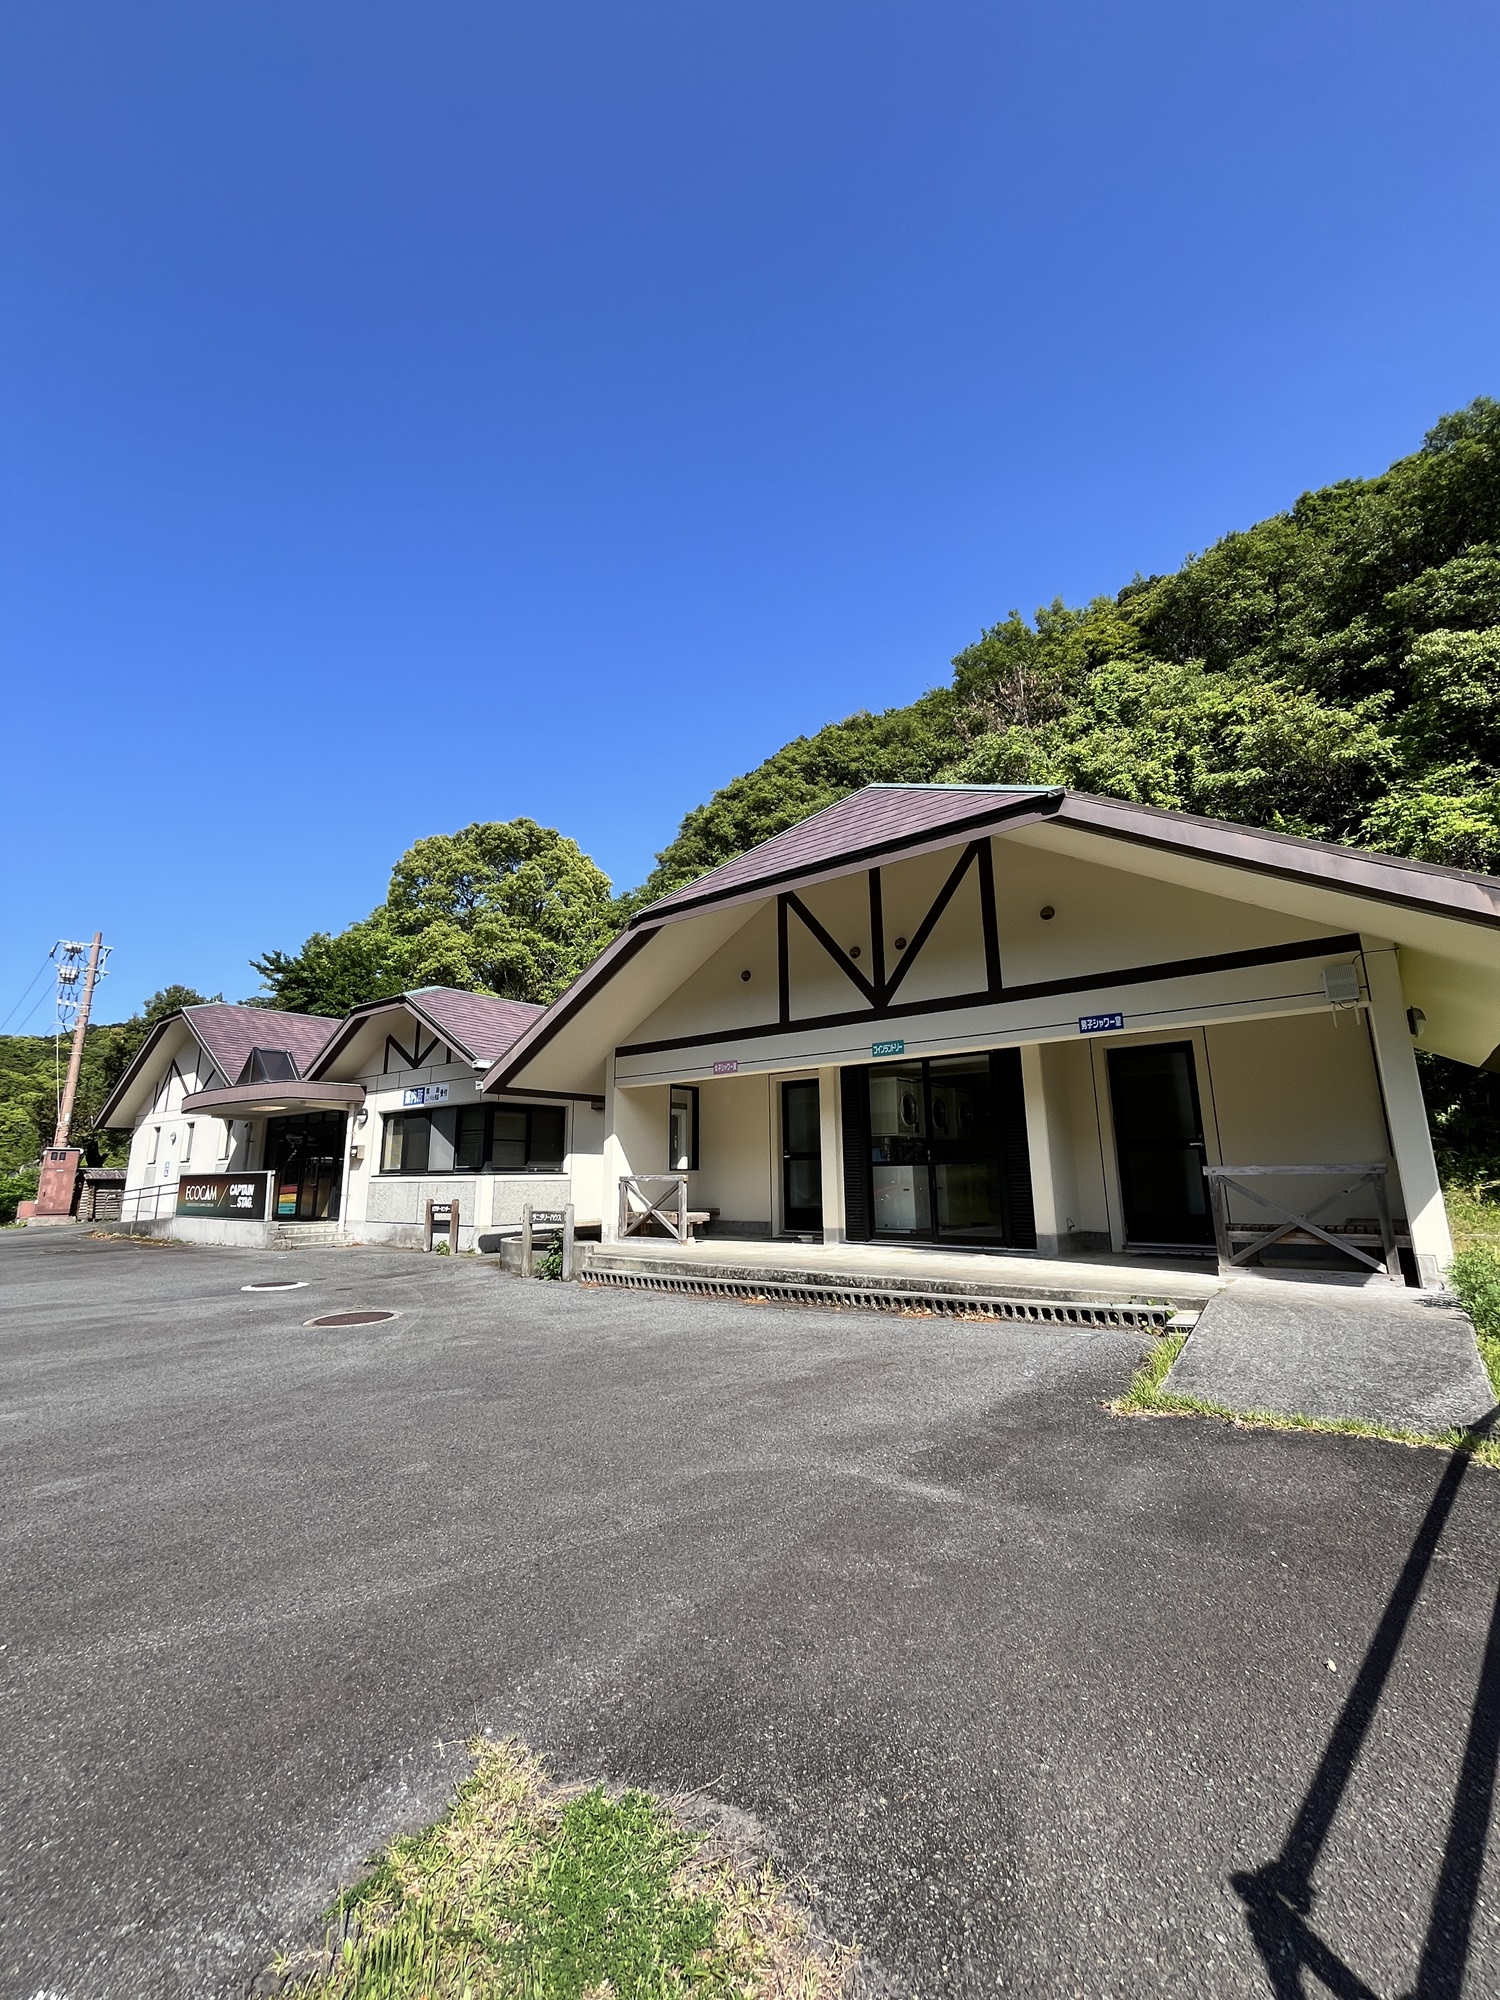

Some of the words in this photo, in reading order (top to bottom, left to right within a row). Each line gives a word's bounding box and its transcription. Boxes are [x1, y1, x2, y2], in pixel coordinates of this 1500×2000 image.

[1081, 1016, 1122, 1030] 男子シャワー室
[873, 1043, 902, 1054] コインランドリー
[404, 1089, 424, 1105] 案内所
[185, 1185, 217, 1201] ECOCAM
[229, 1184, 255, 1196] CAPTAIN
[532, 1213, 562, 1221] サニタリーハウス
